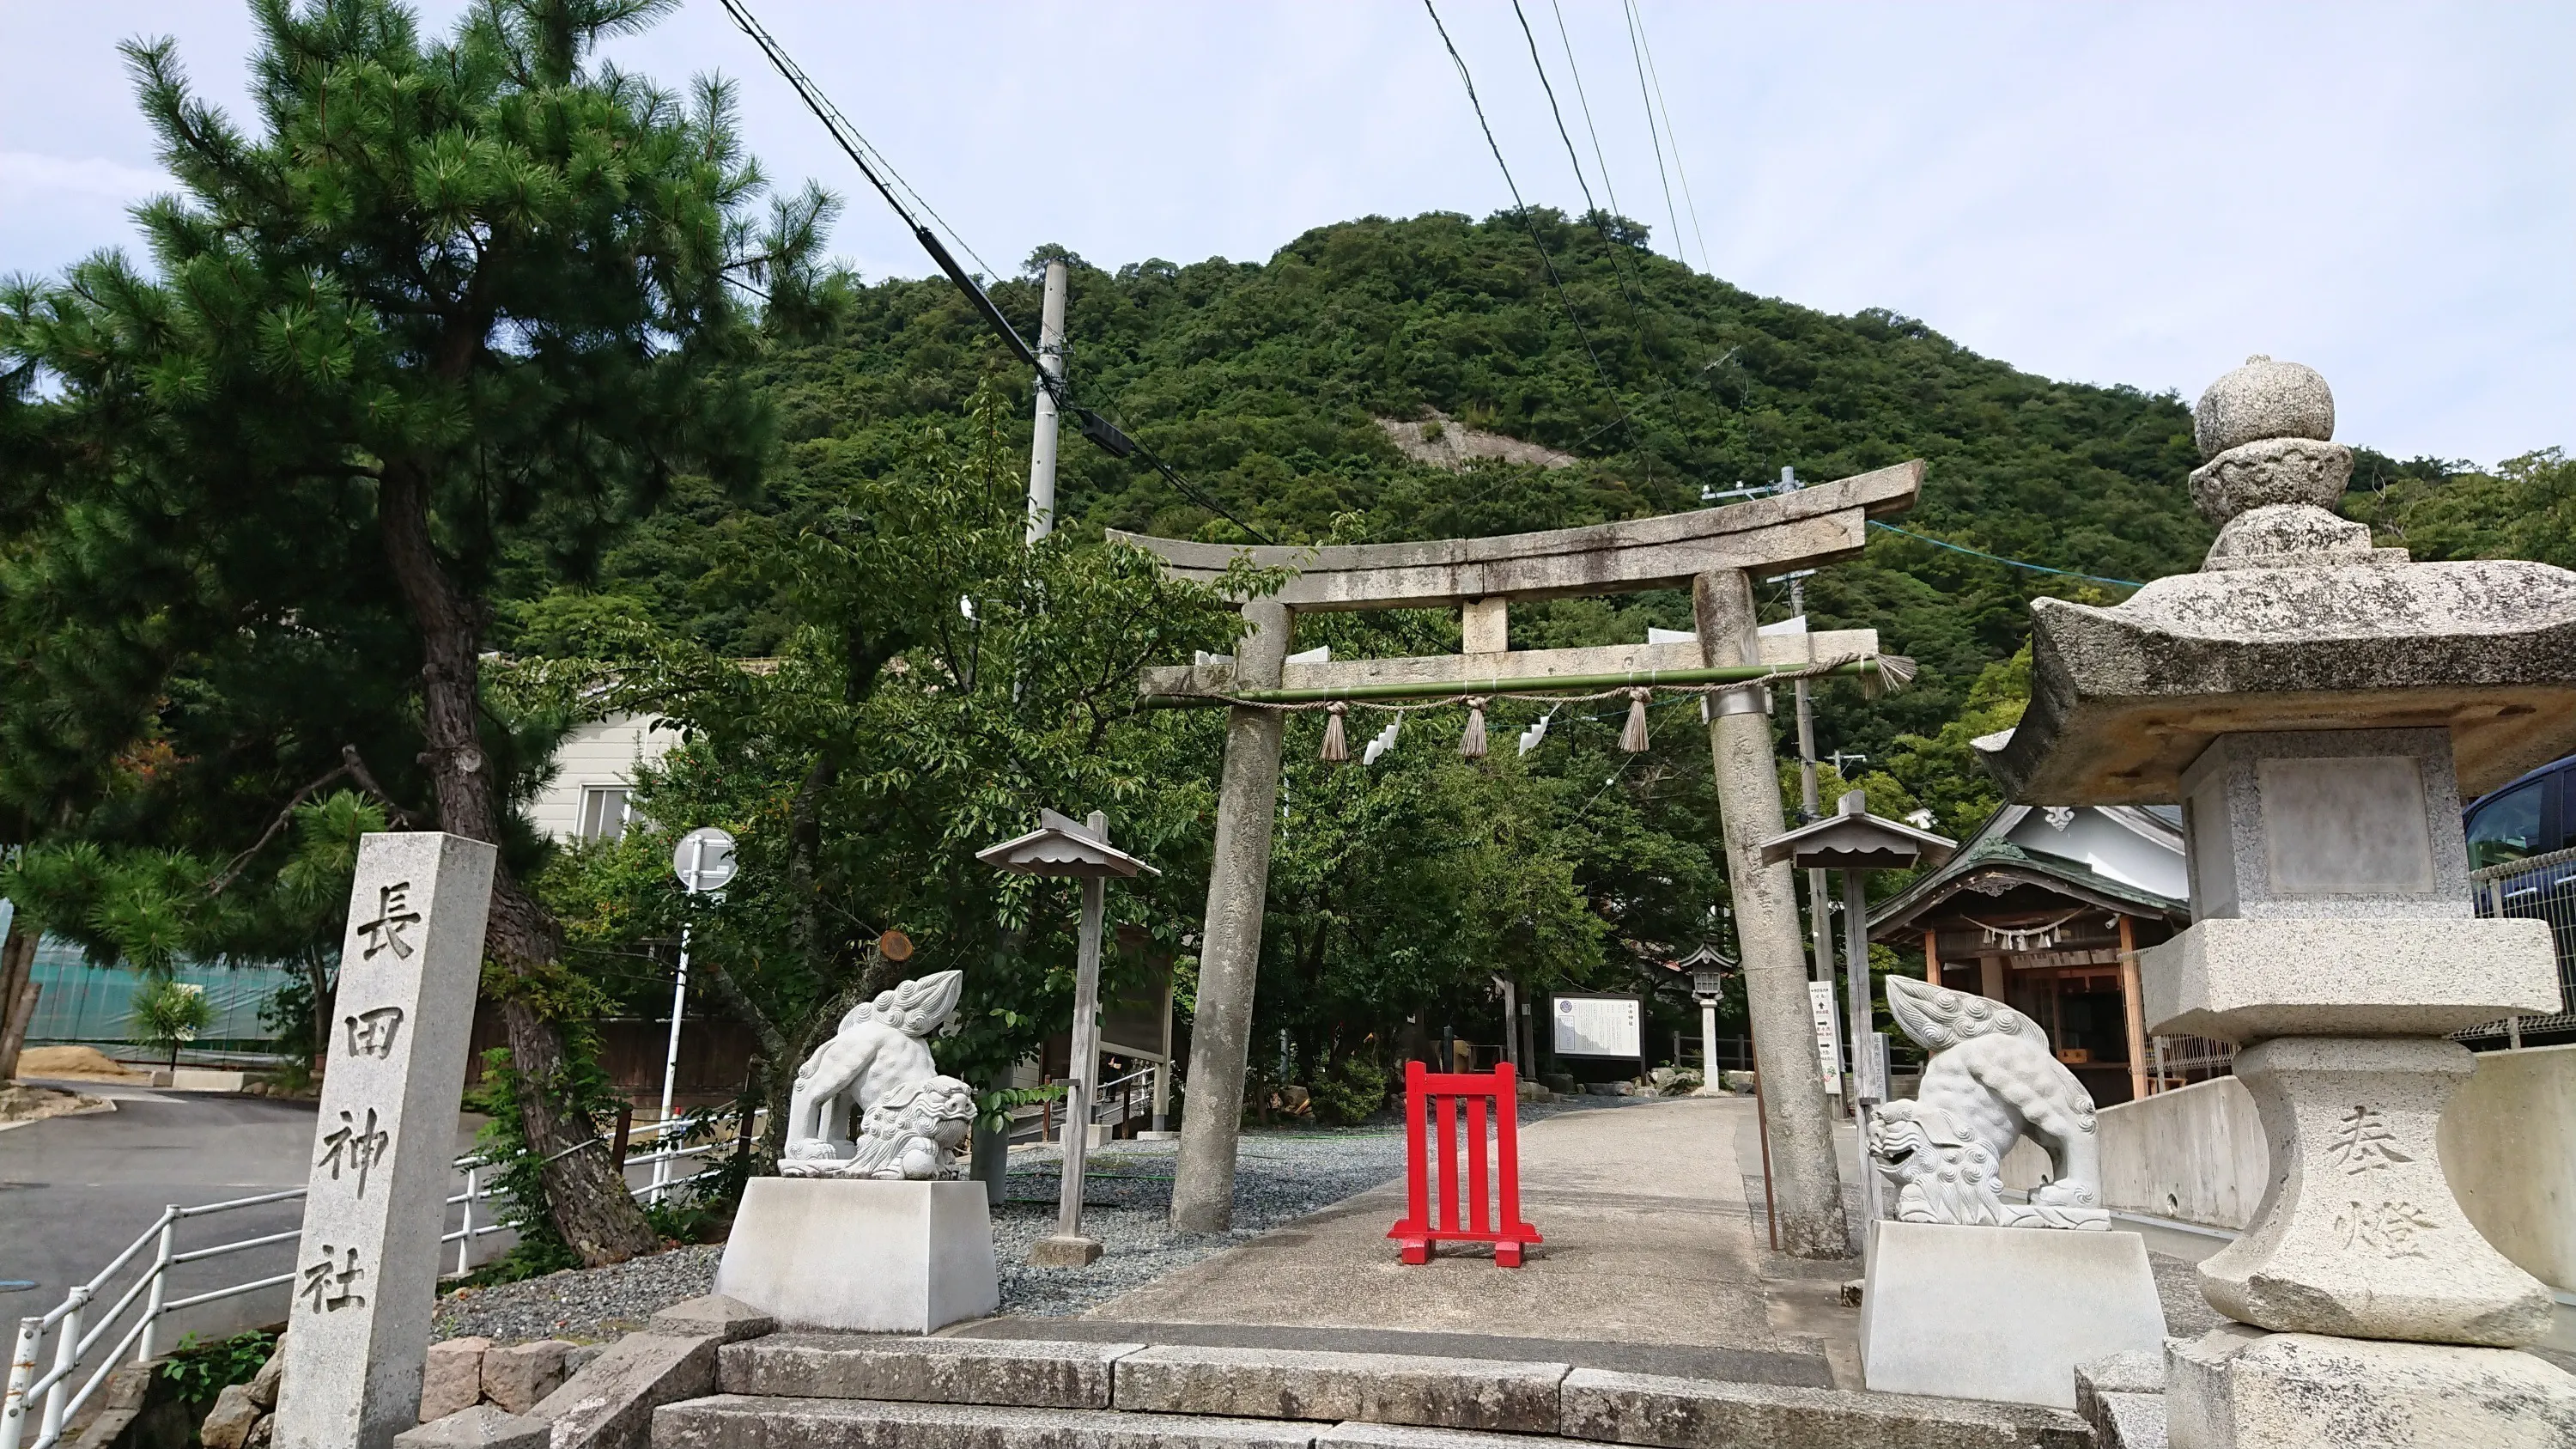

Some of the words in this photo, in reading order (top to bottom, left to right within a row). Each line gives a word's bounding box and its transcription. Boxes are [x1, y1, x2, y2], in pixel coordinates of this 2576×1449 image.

[299, 880, 422, 1316] 長田神社
[2326, 1104, 2441, 1261] 奉燈
